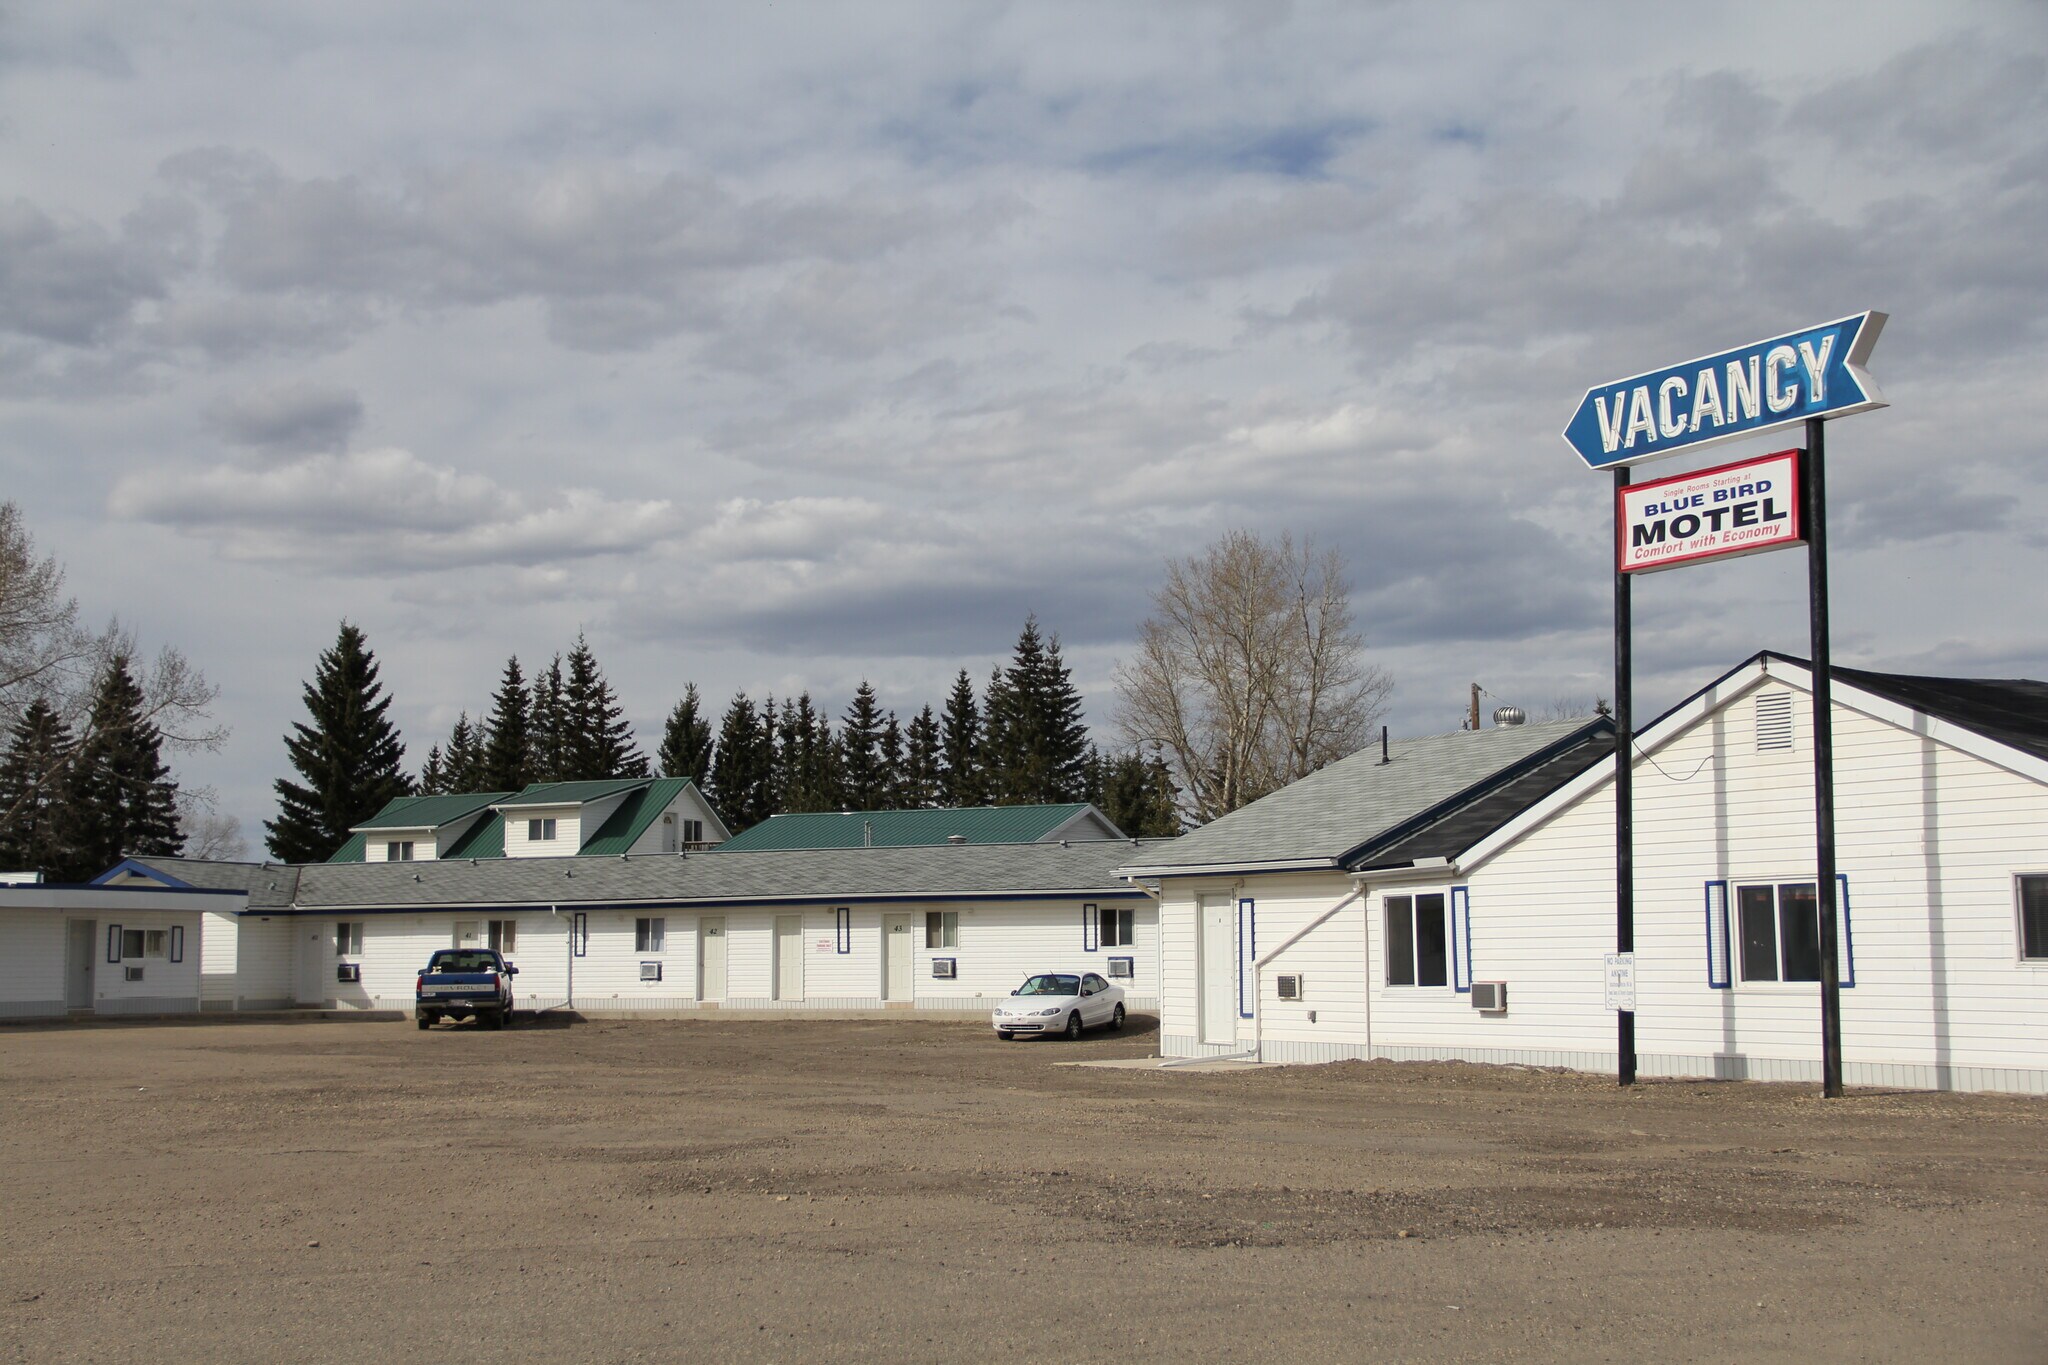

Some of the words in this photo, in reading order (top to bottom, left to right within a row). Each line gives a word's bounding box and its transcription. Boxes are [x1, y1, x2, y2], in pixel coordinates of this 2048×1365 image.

[1594, 334, 1836, 454] VACANCY
[1644, 494, 1705, 517] BLUE
[1713, 480, 1772, 503] BIRD
[1663, 488, 1684, 498] Single
[1687, 482, 1710, 493] Rooms
[1713, 475, 1741, 488] Starting
[1632, 497, 1787, 548] MOTEL
[1635, 540, 1684, 560] Comfort
[1690, 533, 1716, 549] with
[1722, 523, 1781, 544] Economy
[1607, 957, 1613, 965] NO
[1615, 957, 1632, 965] PARKING
